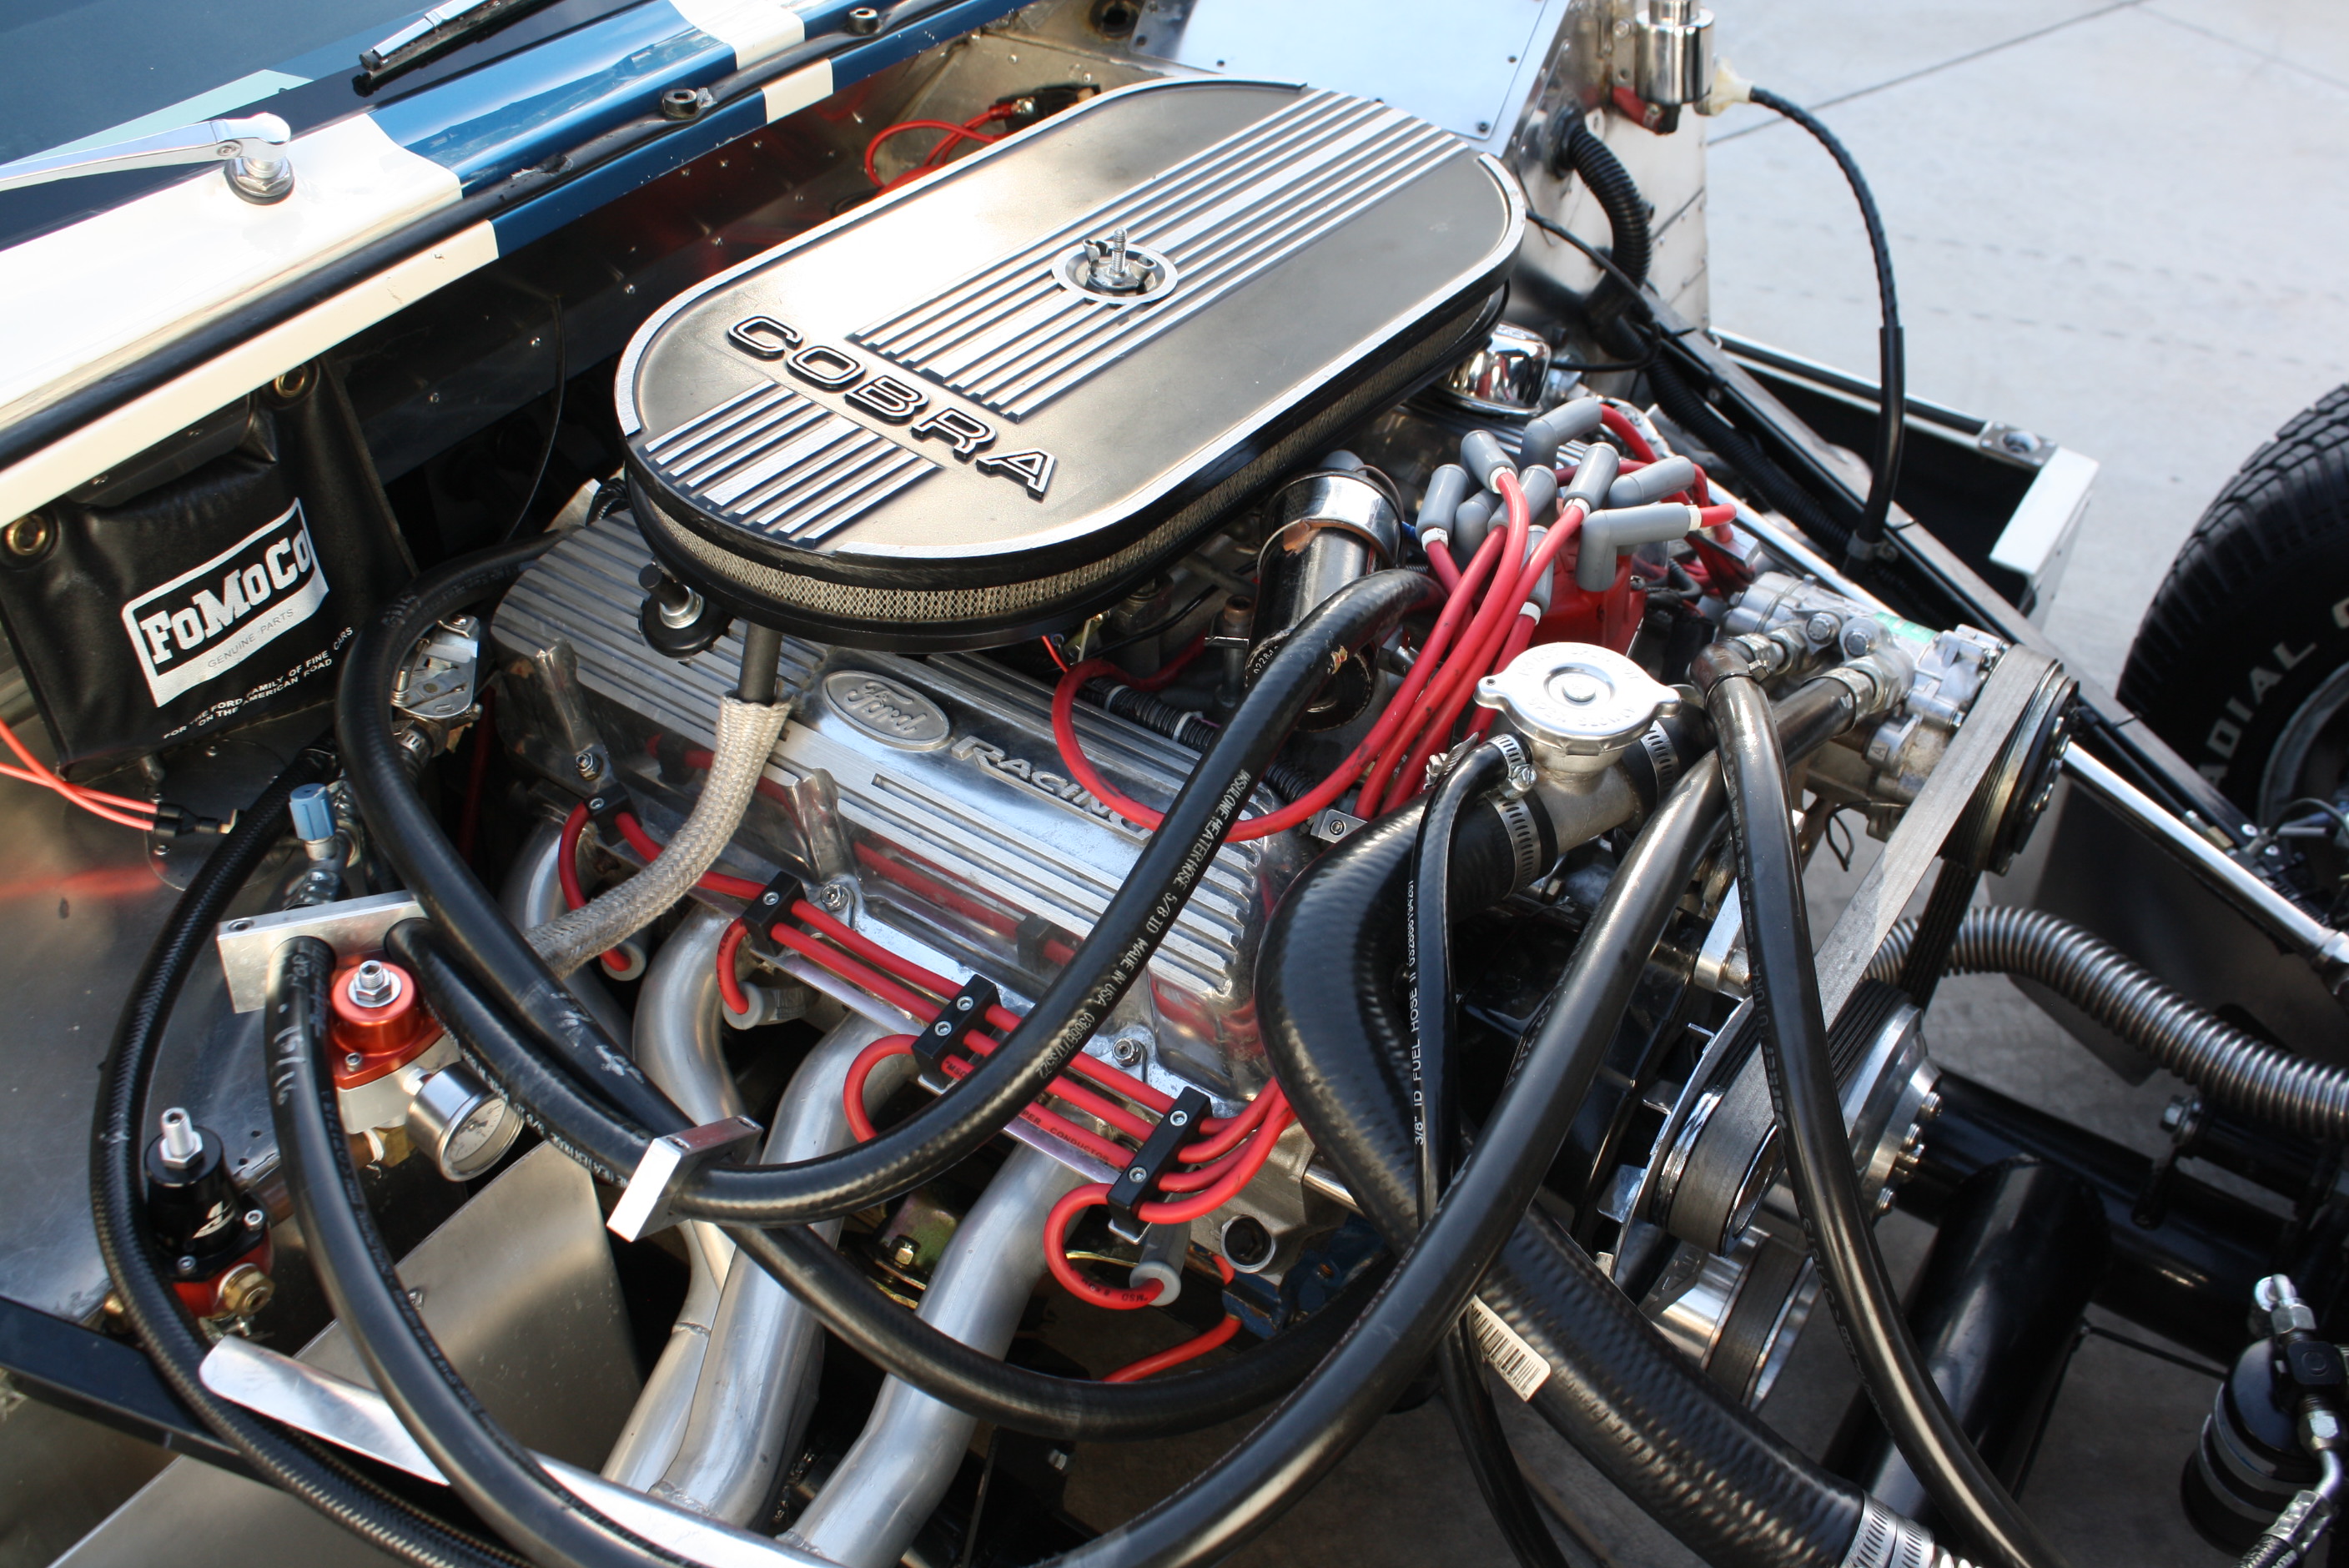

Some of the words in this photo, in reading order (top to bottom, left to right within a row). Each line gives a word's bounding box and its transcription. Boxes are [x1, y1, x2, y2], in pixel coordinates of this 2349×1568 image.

[727, 315, 1057, 500] COBRA
[139, 529, 311, 665] FoMoCo
[208, 634, 257, 668] GENUINE
[259, 609, 294, 635] PARTS
[211, 697, 244, 711] FORD
[289, 665, 303, 677] OF
[305, 651, 330, 667] FINE
[333, 626, 355, 651] CARS
[198, 715, 214, 726] ON
[845, 681, 931, 733] Ford
[2197, 641, 2317, 789] ADIAL
[1190, 816, 1224, 862] HEATER
[1172, 858, 1199, 891] HOSE
[1155, 892, 1179, 918] 5/8
[1145, 916, 1164, 934] ID
[1119, 937, 1149, 972] MADE
[1111, 968, 1127, 985] IN
[1094, 983, 1118, 1008] USA
[1409, 987, 1420, 1033] HOSE
[1411, 1038, 1422, 1082] FUEL
[1413, 1090, 1423, 1108] ID
[1049, 1127, 1111, 1162] CONDUCTOR
[1414, 1116, 1425, 1146] 3/8"
